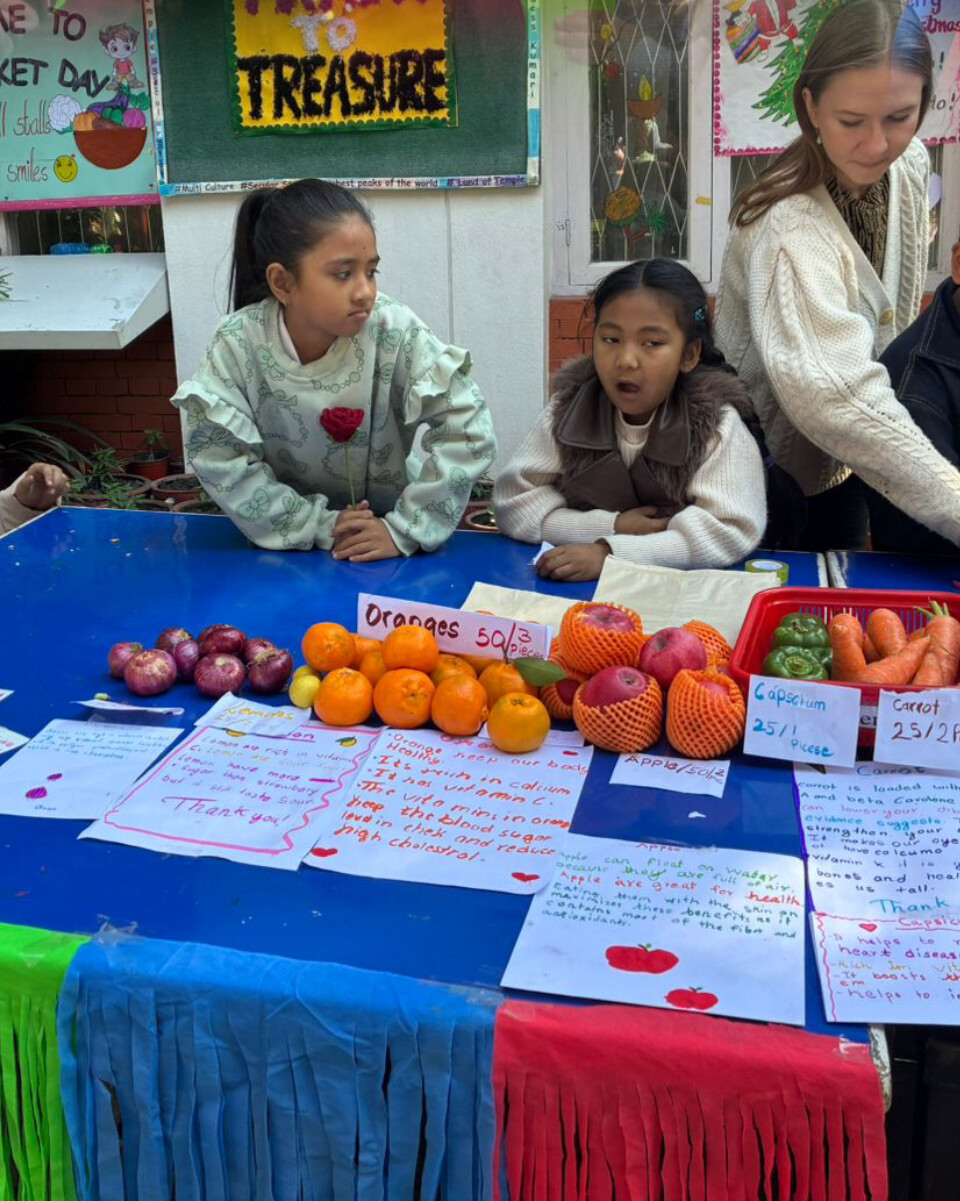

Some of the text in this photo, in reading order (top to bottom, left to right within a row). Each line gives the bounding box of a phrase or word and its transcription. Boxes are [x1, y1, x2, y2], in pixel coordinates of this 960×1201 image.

[48, 7, 87, 41] TO
[291, 13, 357, 56] TO
[57, 58, 111, 98] DAY
[237, 49, 447, 120] TREASURE
[6, 147, 49, 183] smiles
[397, 177, 412, 187] the
[415, 178, 438, 188] world
[365, 602, 459, 639] Oranges
[892, 698, 941, 716] Carrot
[511, 758, 542, 767] our
[162, 796, 249, 818] Thank
[872, 873, 908, 883] and
[868, 896, 950, 915] Thank
